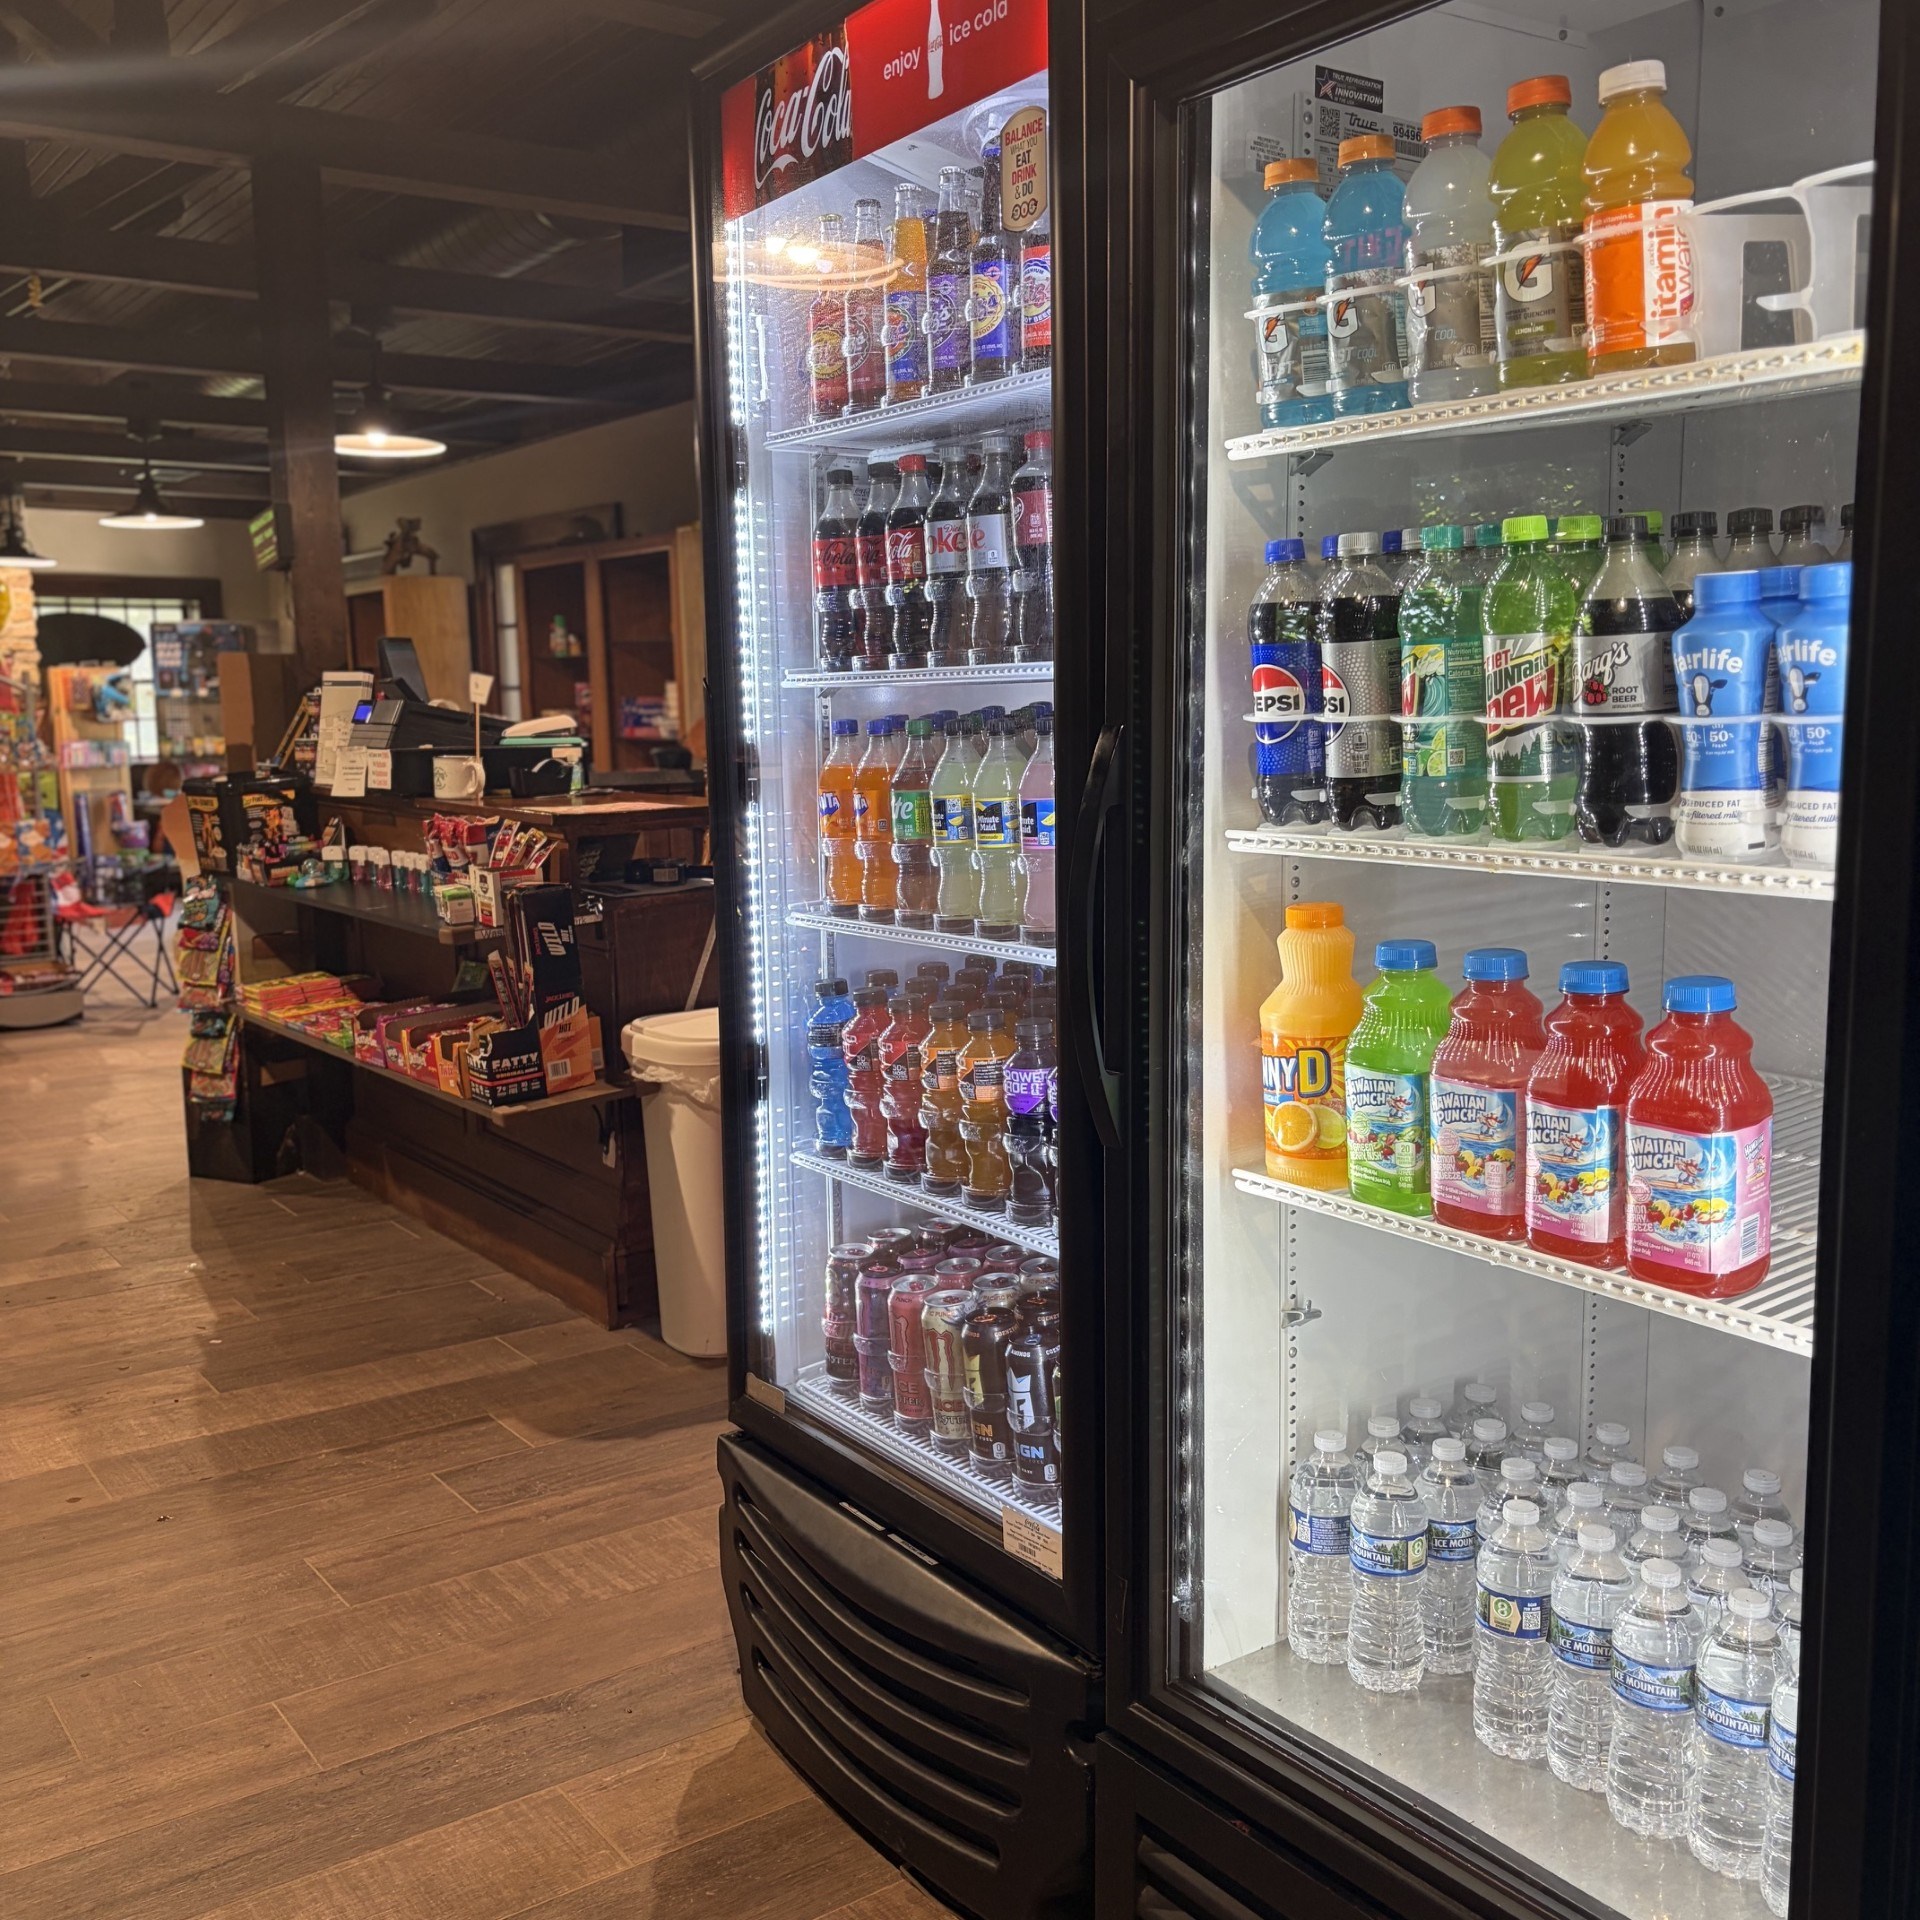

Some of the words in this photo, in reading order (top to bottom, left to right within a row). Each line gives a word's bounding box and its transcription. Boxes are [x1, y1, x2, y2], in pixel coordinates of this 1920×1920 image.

[883, 47, 921, 80] enjoy
[949, 23, 971, 46] ice
[974, 0, 1009, 31] cold
[754, 46, 852, 190] Coca-Cola
[1004, 117, 1044, 147] BALANCE
[1010, 139, 1025, 155] WHAT
[1027, 135, 1038, 148] YOU
[1016, 149, 1032, 168] EAT
[1012, 163, 1037, 185] DRINK
[1015, 185, 1021, 199] &
[1022, 180, 1033, 197] DO
[1572, 641, 1631, 703] Barq's
[1612, 686, 1639, 694] ROOT
[1612, 695, 1637, 703] BEER
[1256, 693, 1300, 712] EPSI
[544, 996, 580, 1030] WILD
[491, 1052, 539, 1070] FATTY
[1350, 1093, 1387, 1109] PUNCH
[1436, 1108, 1476, 1126] PUNCH
[1628, 1153, 1675, 1172] PUNCH
[1434, 1538, 1448, 1547] ICE
[1353, 1544, 1391, 1564] MOUNTAIN
[1559, 1637, 1572, 1648] ICE
[1614, 1668, 1624, 1680] ICE
[1625, 1679, 1677, 1697] MOUNTAIN
[1707, 1708, 1761, 1734] MOUNTAIN
